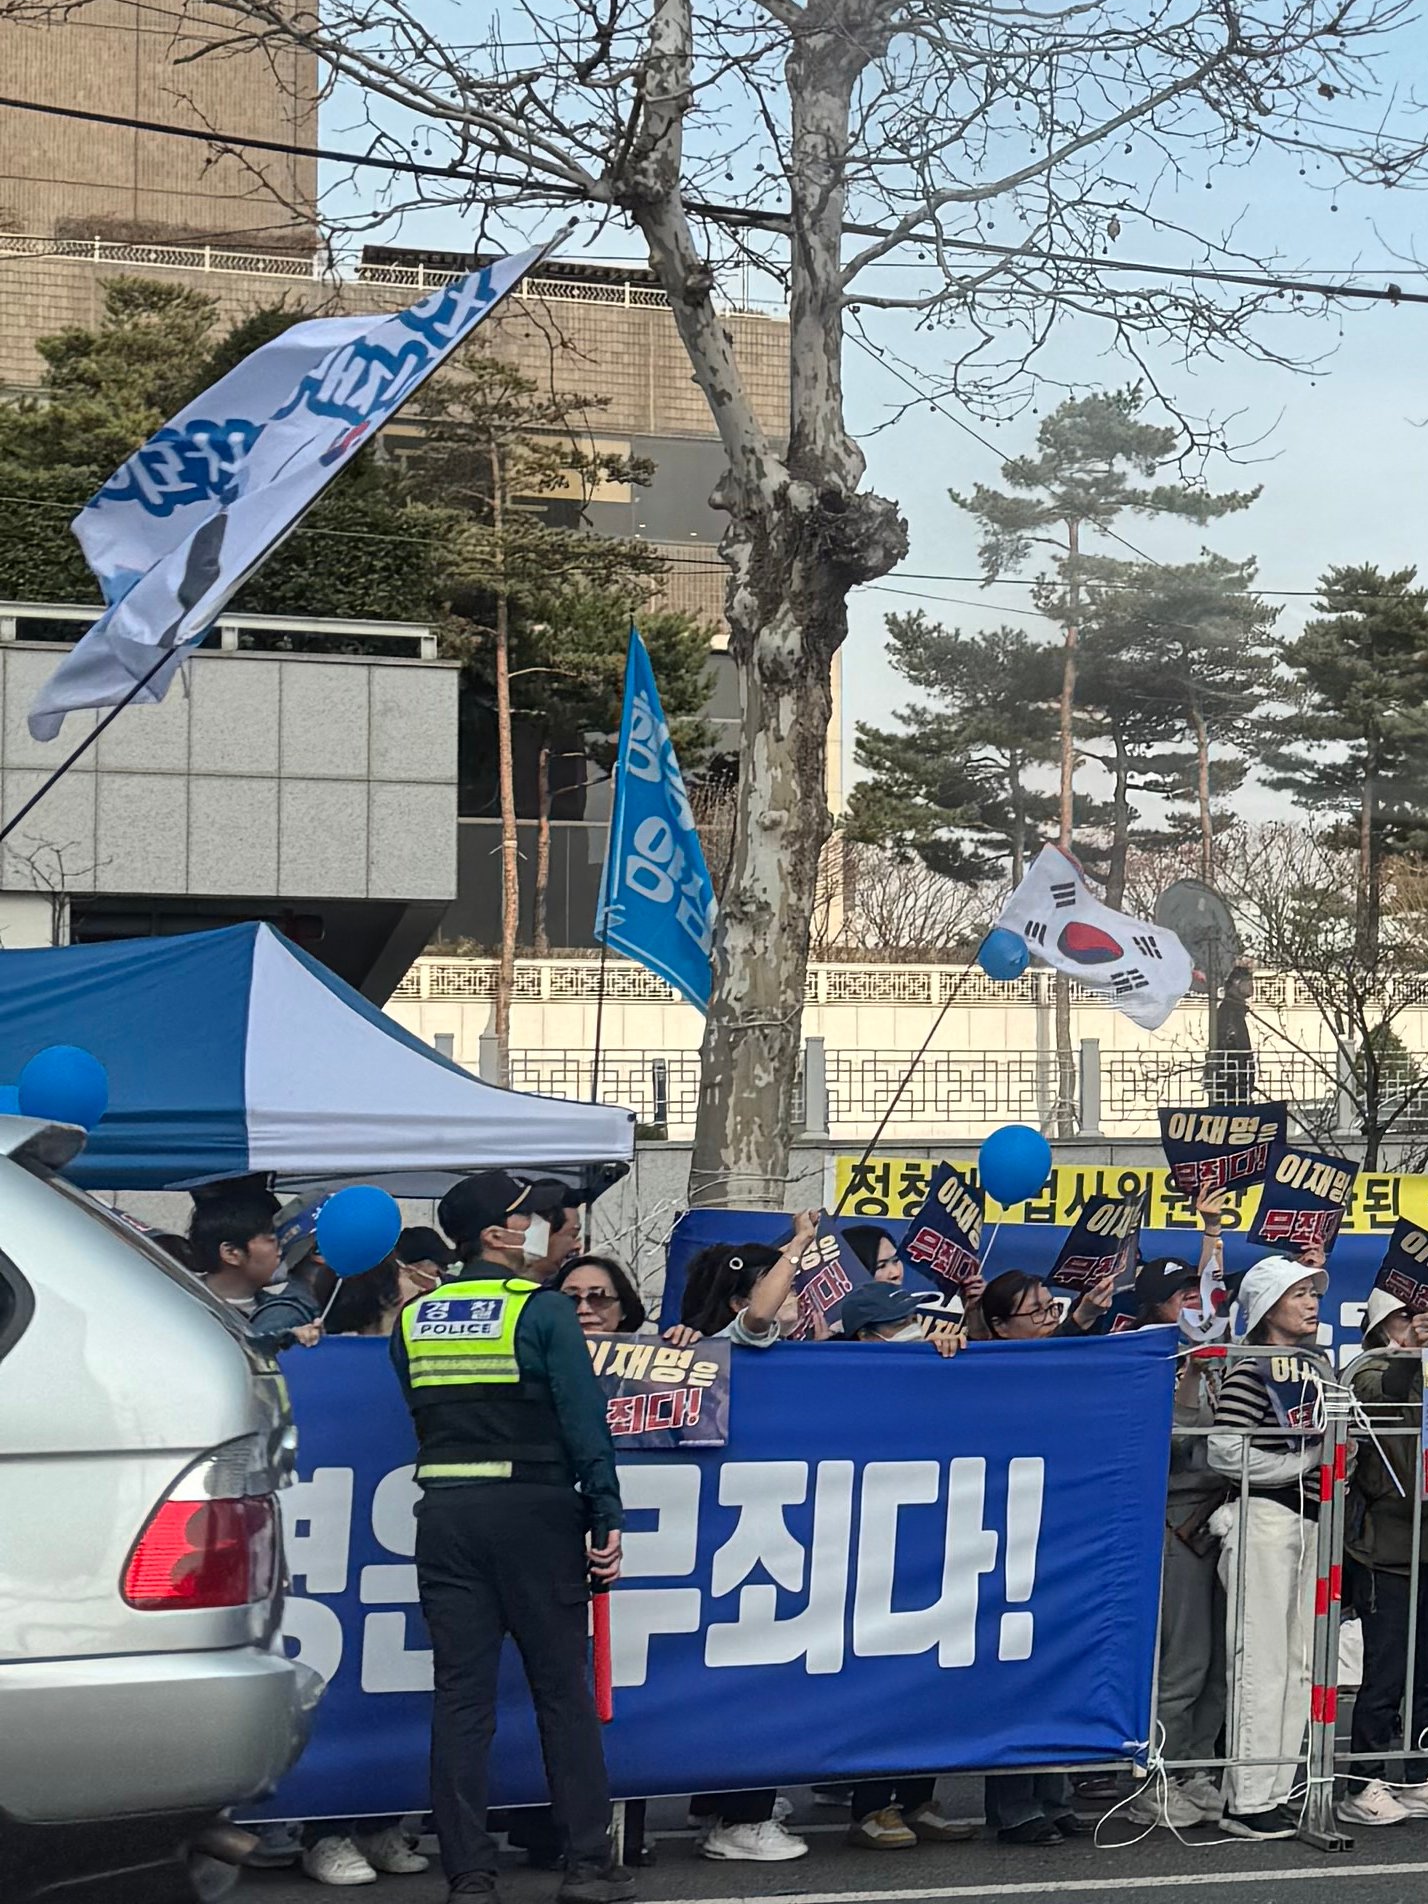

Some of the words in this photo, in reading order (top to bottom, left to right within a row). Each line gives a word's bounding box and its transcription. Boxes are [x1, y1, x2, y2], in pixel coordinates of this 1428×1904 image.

[1168, 1112, 1279, 1145] 이재명은
[851, 1162, 978, 1217] 정청
[420, 1321, 492, 1336] POLICE
[586, 1456, 1045, 1689] 무죄다!
